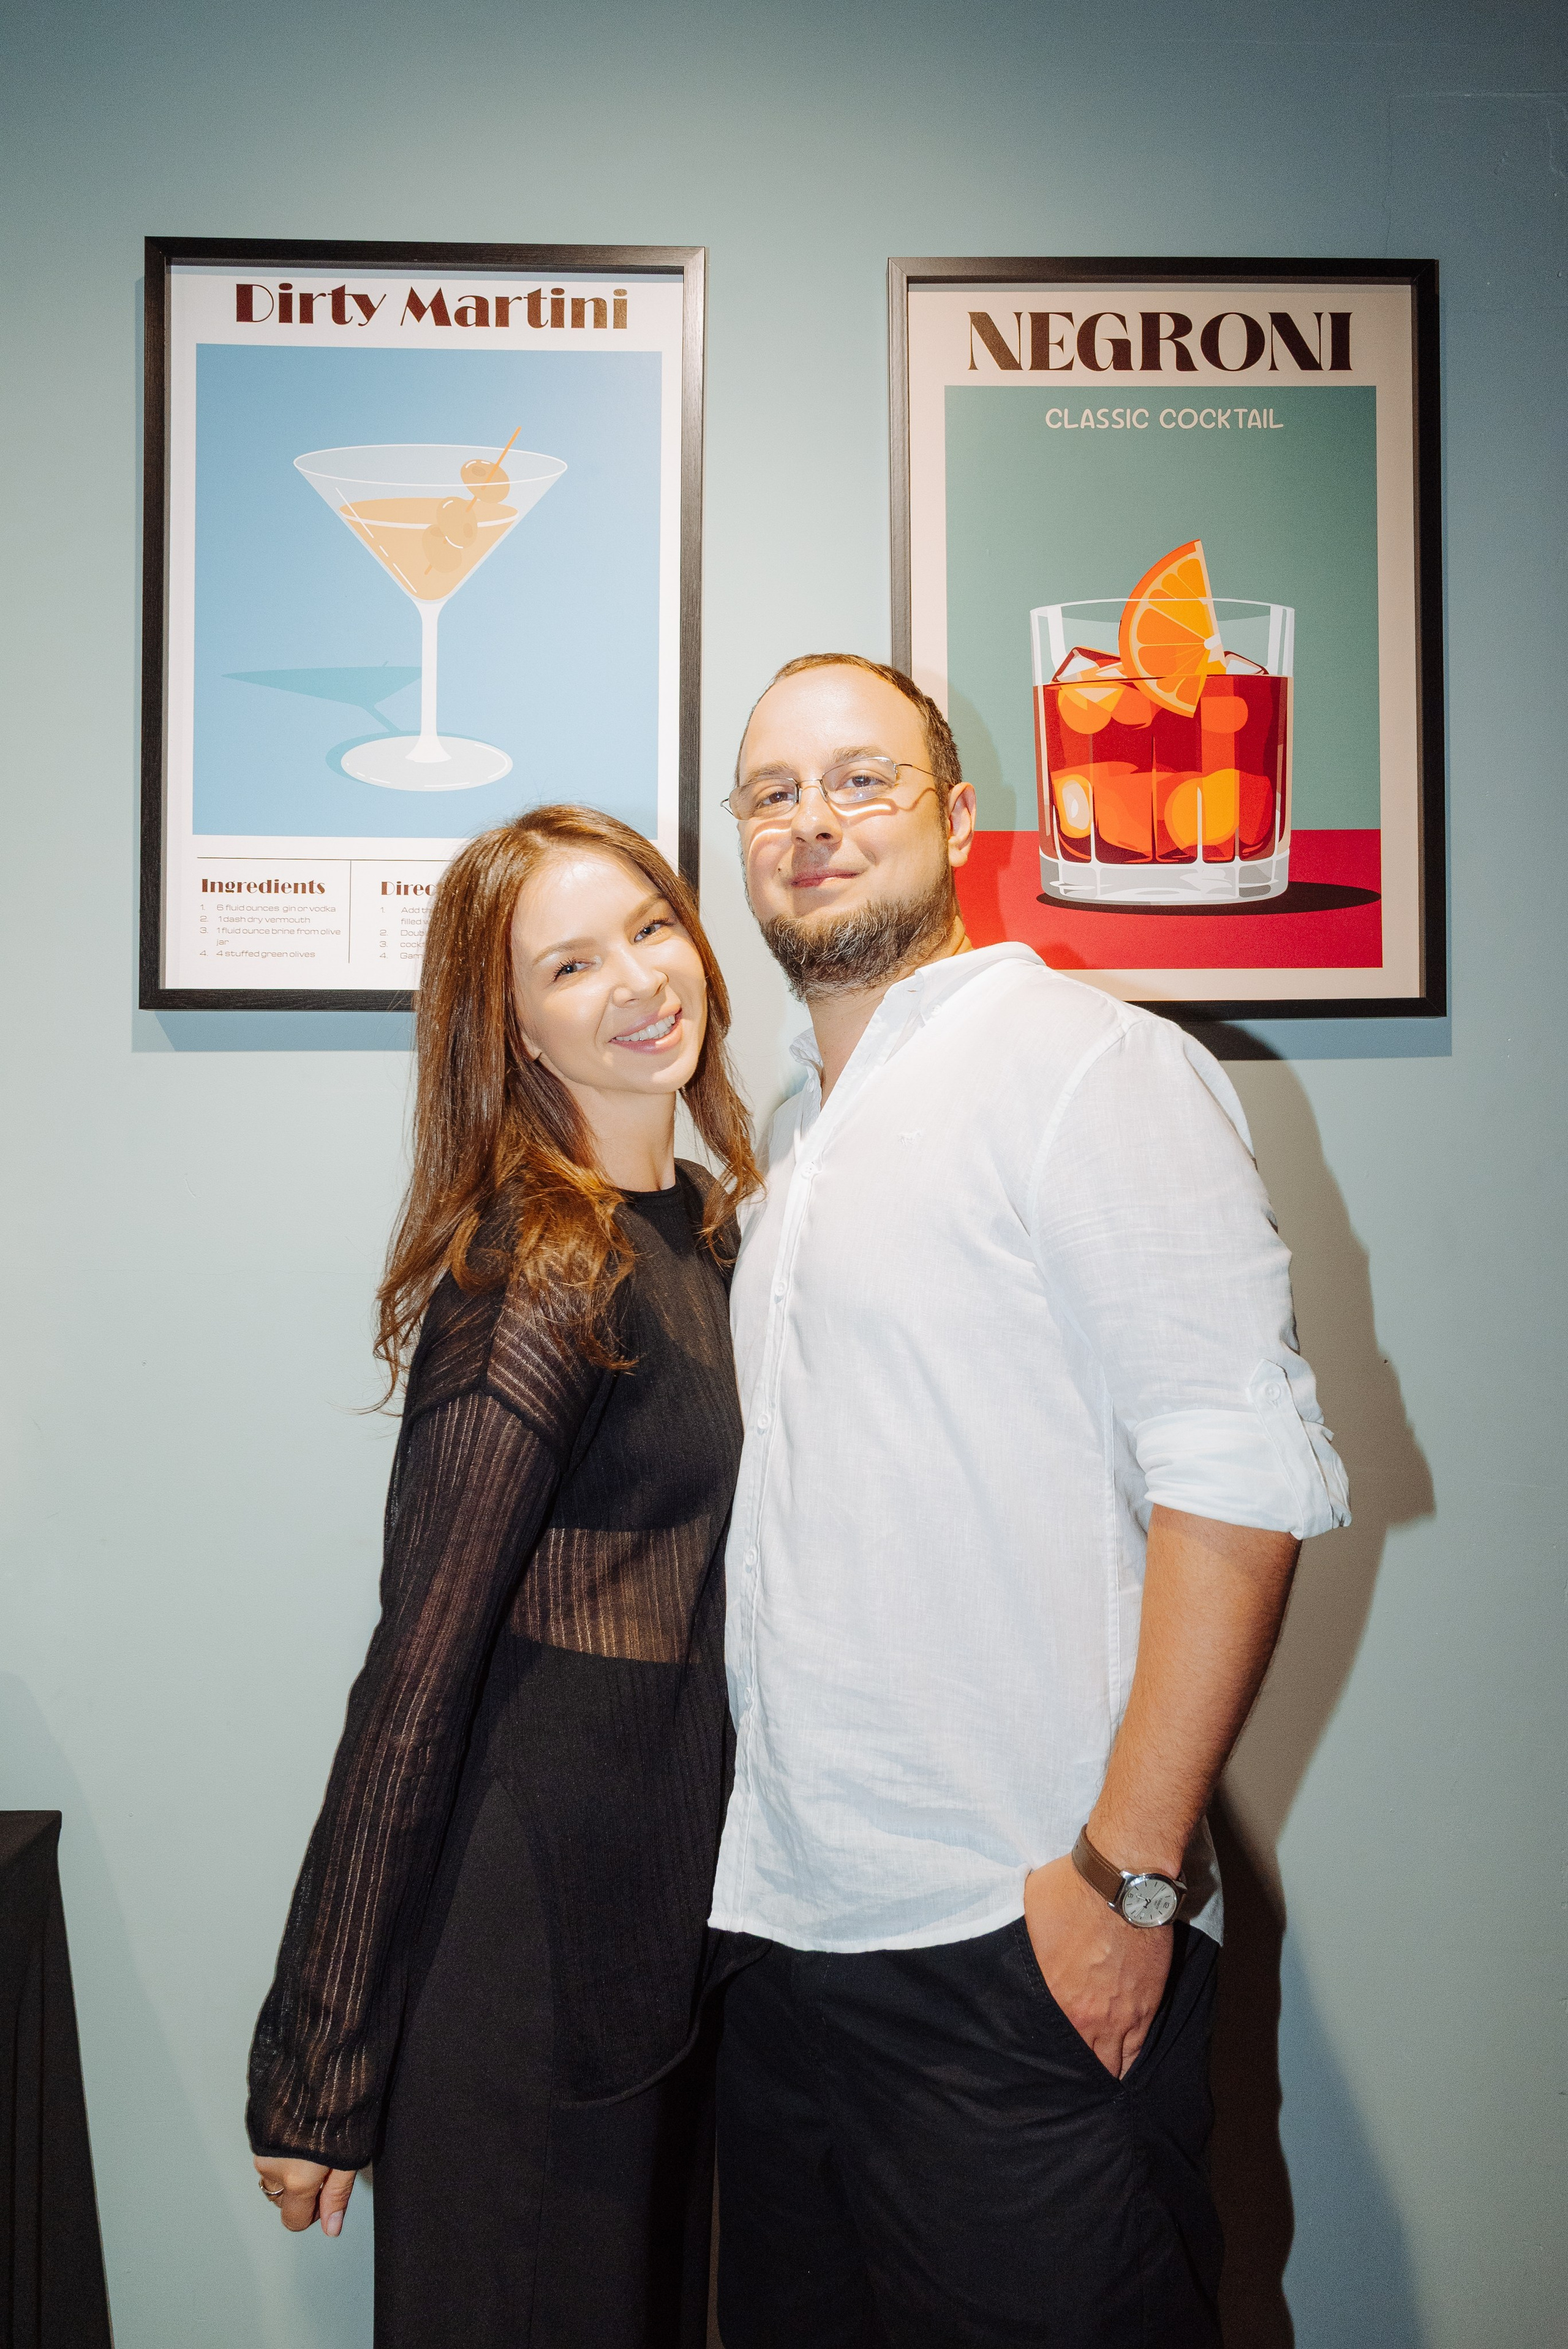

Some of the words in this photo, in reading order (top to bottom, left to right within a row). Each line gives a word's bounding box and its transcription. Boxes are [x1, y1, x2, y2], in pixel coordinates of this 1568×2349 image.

[236, 282, 386, 326] Dirty
[400, 286, 628, 330] Martini
[967, 311, 1354, 372] NEGRONI
[1045, 407, 1150, 429] CLASSIC
[1159, 407, 1284, 429] COCKTAIL
[202, 878, 326, 895] Ingredients
[381, 881, 437, 896] Direc
